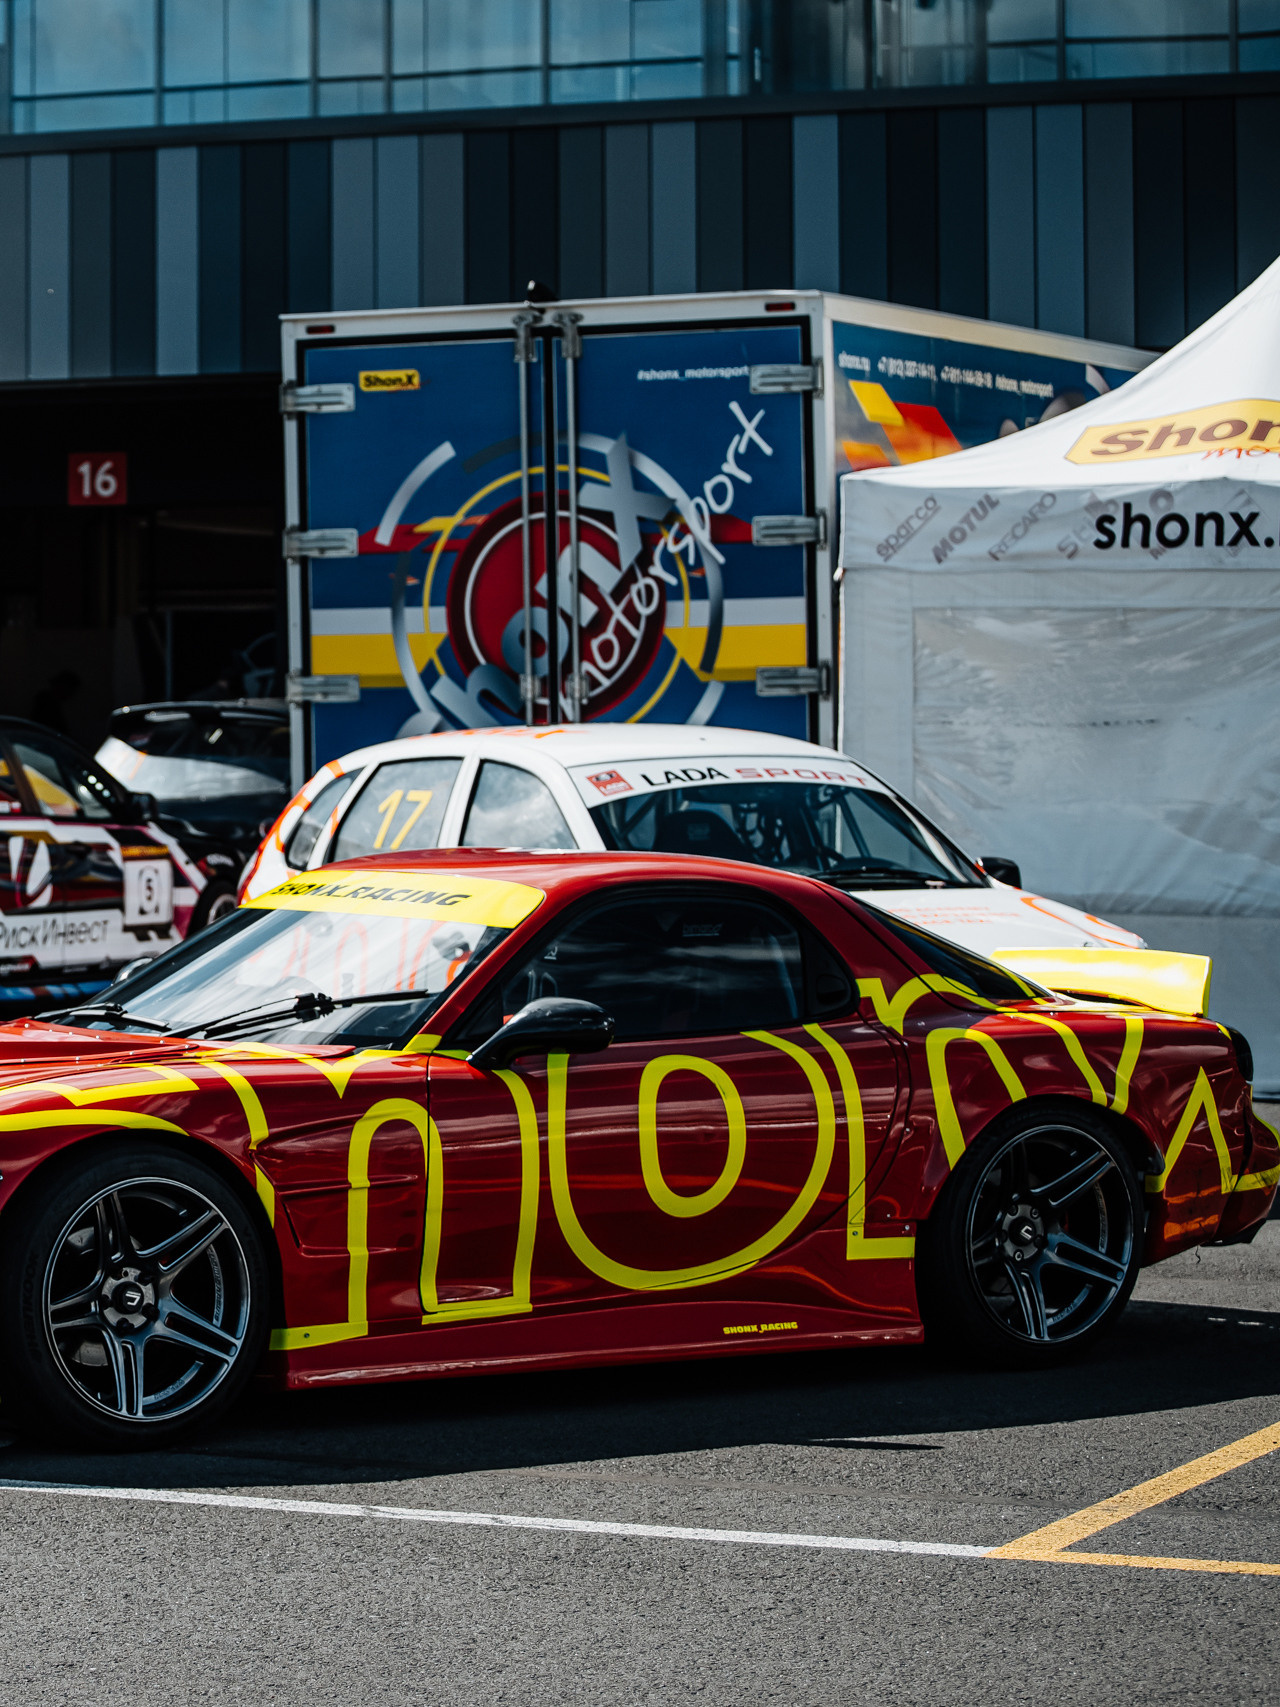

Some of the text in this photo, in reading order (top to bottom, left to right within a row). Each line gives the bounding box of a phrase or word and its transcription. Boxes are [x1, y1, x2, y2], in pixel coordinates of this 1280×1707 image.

[78, 461, 117, 497] 16
[932, 494, 999, 564] MOTUL
[988, 492, 1057, 561] RECARO
[1094, 502, 1280, 550] shonx.
[640, 767, 868, 786] LADA SPORT
[378, 789, 433, 850] 17
[271, 883, 473, 906] SHONX_RACING
[723, 1322, 798, 1335] SHONX_RACING
